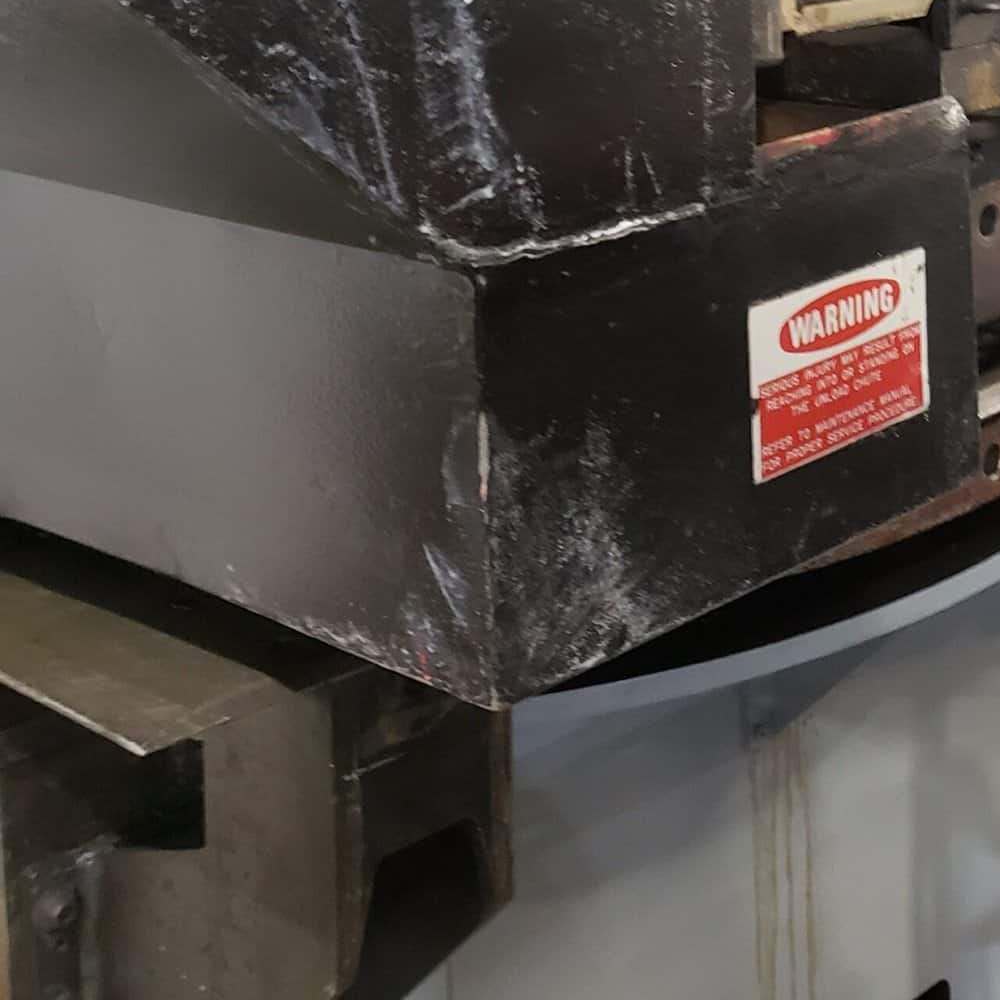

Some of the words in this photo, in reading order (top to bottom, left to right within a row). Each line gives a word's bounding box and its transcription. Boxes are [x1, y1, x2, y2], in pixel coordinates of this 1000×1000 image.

[787, 282, 894, 349] WARNING
[759, 373, 800, 399] SERIOUS
[803, 359, 836, 381] INJURY
[839, 350, 857, 366] MAY
[862, 334, 896, 356] RESULT
[766, 384, 812, 412] REACHING
[816, 373, 837, 391] INTO
[840, 366, 854, 381] OR
[858, 347, 899, 373] STANDING
[901, 341, 914, 355] ON
[790, 400, 809, 417] THE
[814, 384, 849, 407] UNLOAD
[853, 369, 881, 390] CHUTE
[762, 435, 792, 458] REFER
[797, 427, 811, 442] TO
[815, 400, 874, 434] MAINTENANCE
[879, 384, 911, 405] MANUAL
[785, 437, 823, 463] PROPER
[826, 419, 864, 444] SERVICE
